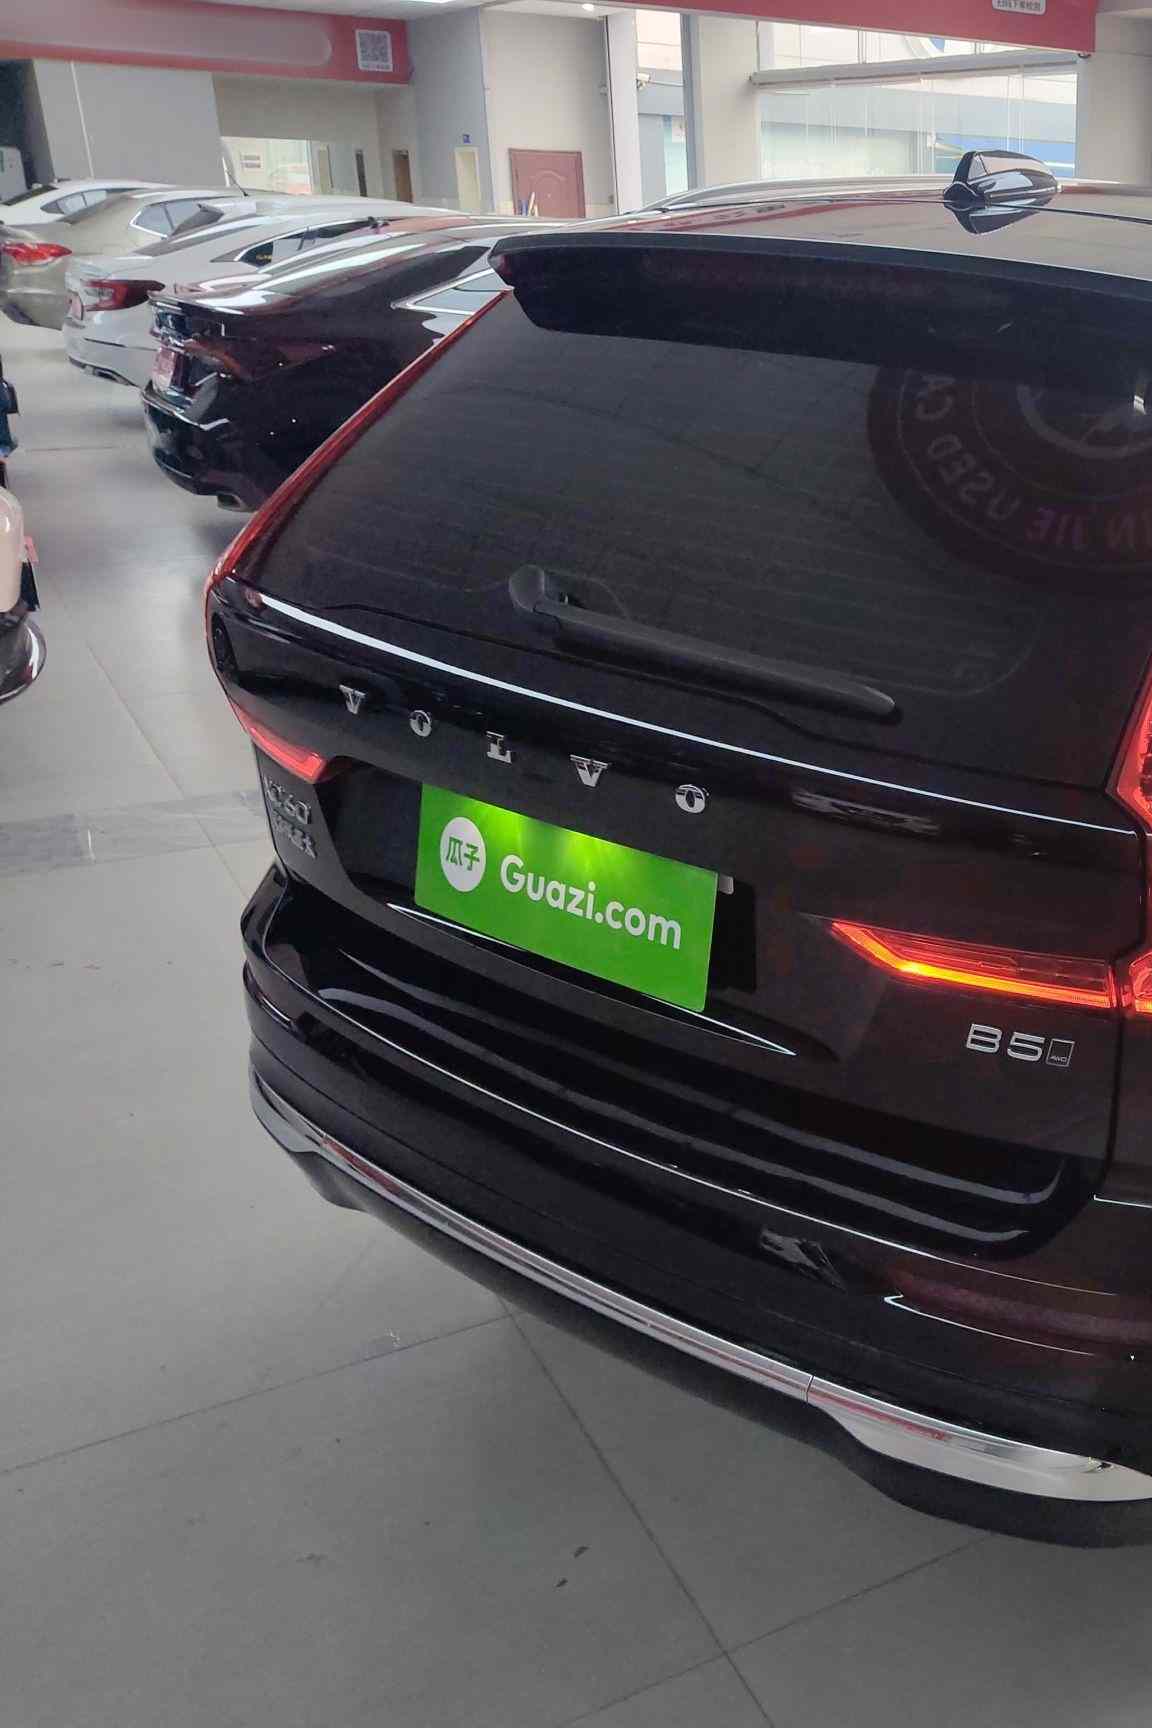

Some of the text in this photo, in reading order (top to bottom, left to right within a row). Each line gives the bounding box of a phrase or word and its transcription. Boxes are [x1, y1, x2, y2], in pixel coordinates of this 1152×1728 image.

[339, 684, 708, 814] VOLVO
[446, 836, 481, 872] 瓜子
[500, 854, 683, 950] Guazi.com
[966, 1023, 1046, 1062] B5
